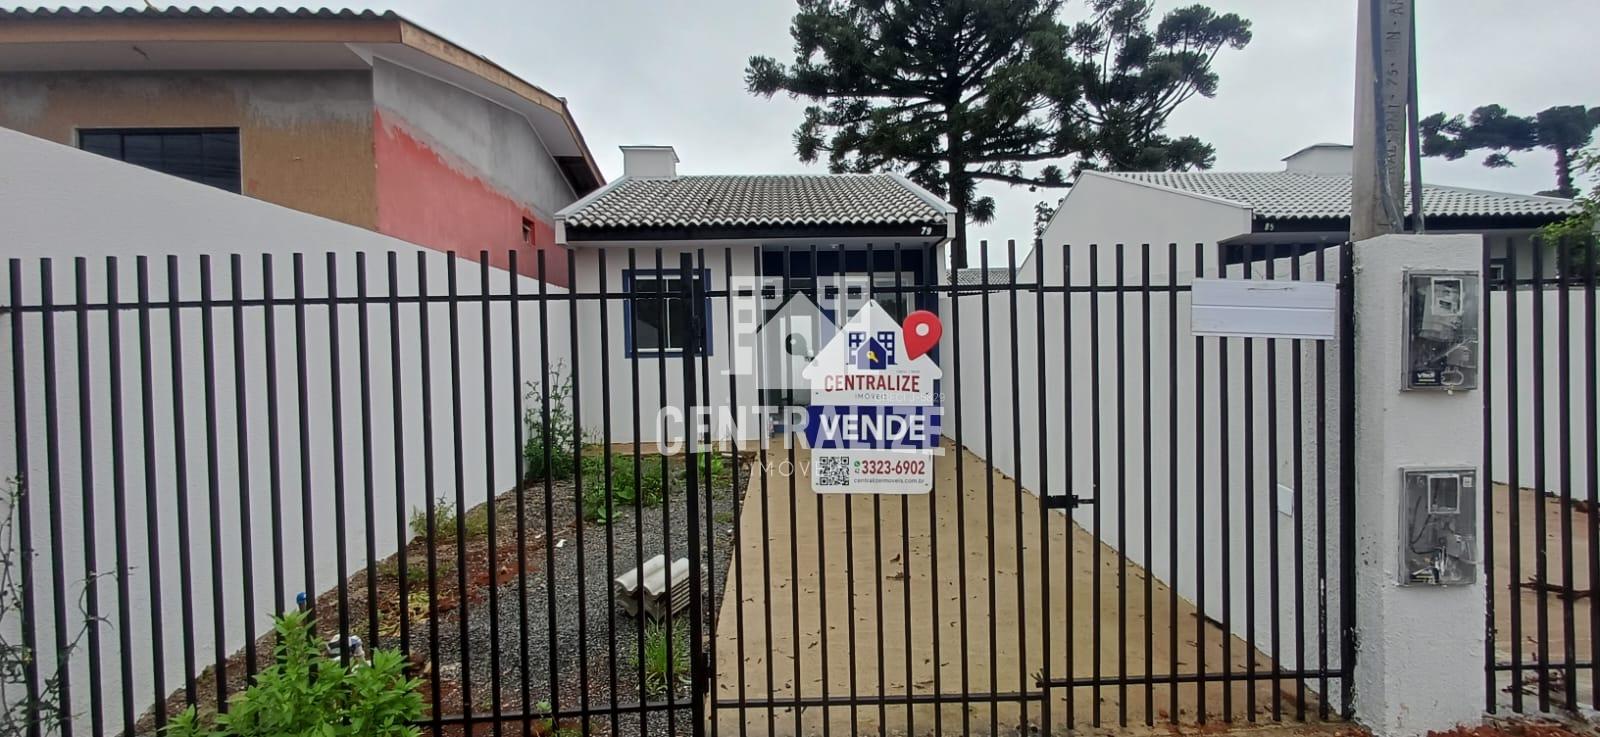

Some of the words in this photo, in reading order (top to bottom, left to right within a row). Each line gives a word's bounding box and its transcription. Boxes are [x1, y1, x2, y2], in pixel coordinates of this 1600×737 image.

[824, 374, 920, 392] CENTRALIZE
[820, 414, 926, 441] VENDE
[861, 460, 926, 475] 3323-6902
